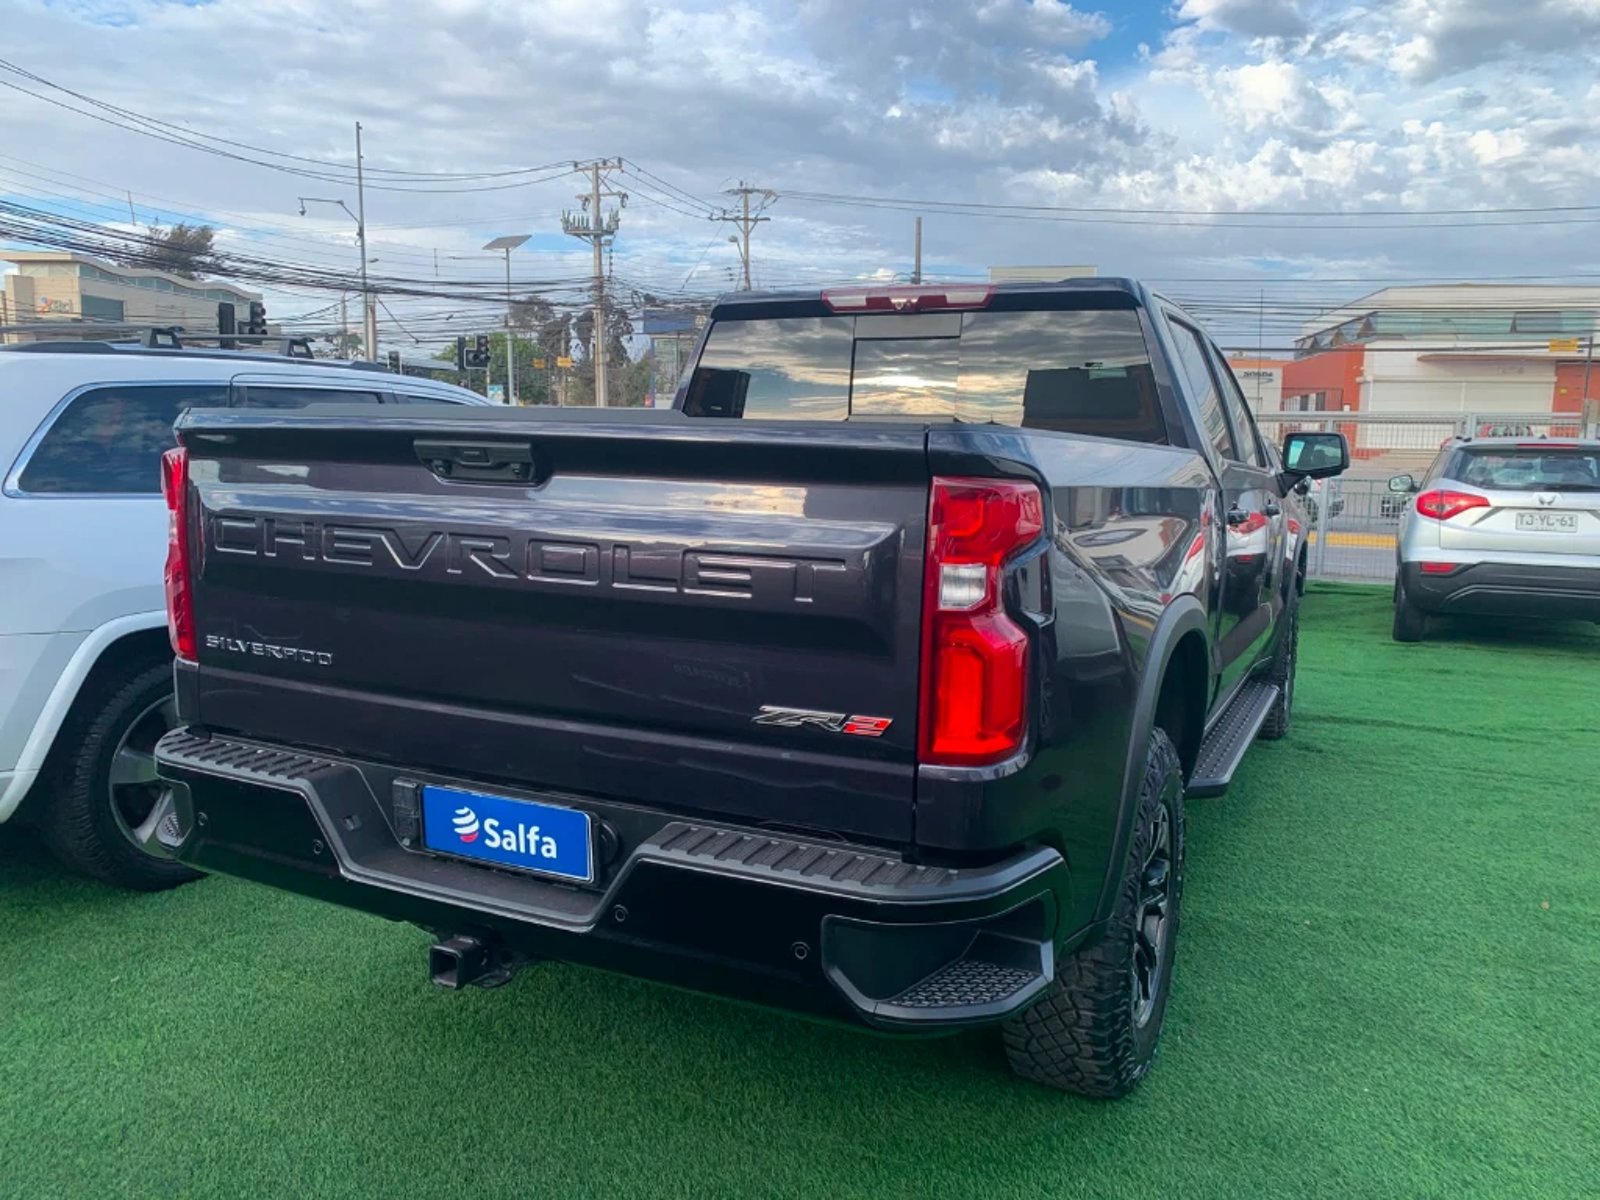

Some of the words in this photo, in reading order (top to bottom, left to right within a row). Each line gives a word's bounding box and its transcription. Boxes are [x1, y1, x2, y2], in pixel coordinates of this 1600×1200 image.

[213, 515, 846, 602] CHEVROLET
[205, 634, 333, 666] SILVERADO
[752, 705, 893, 737] ZR2
[483, 818, 557, 859] Salfa
